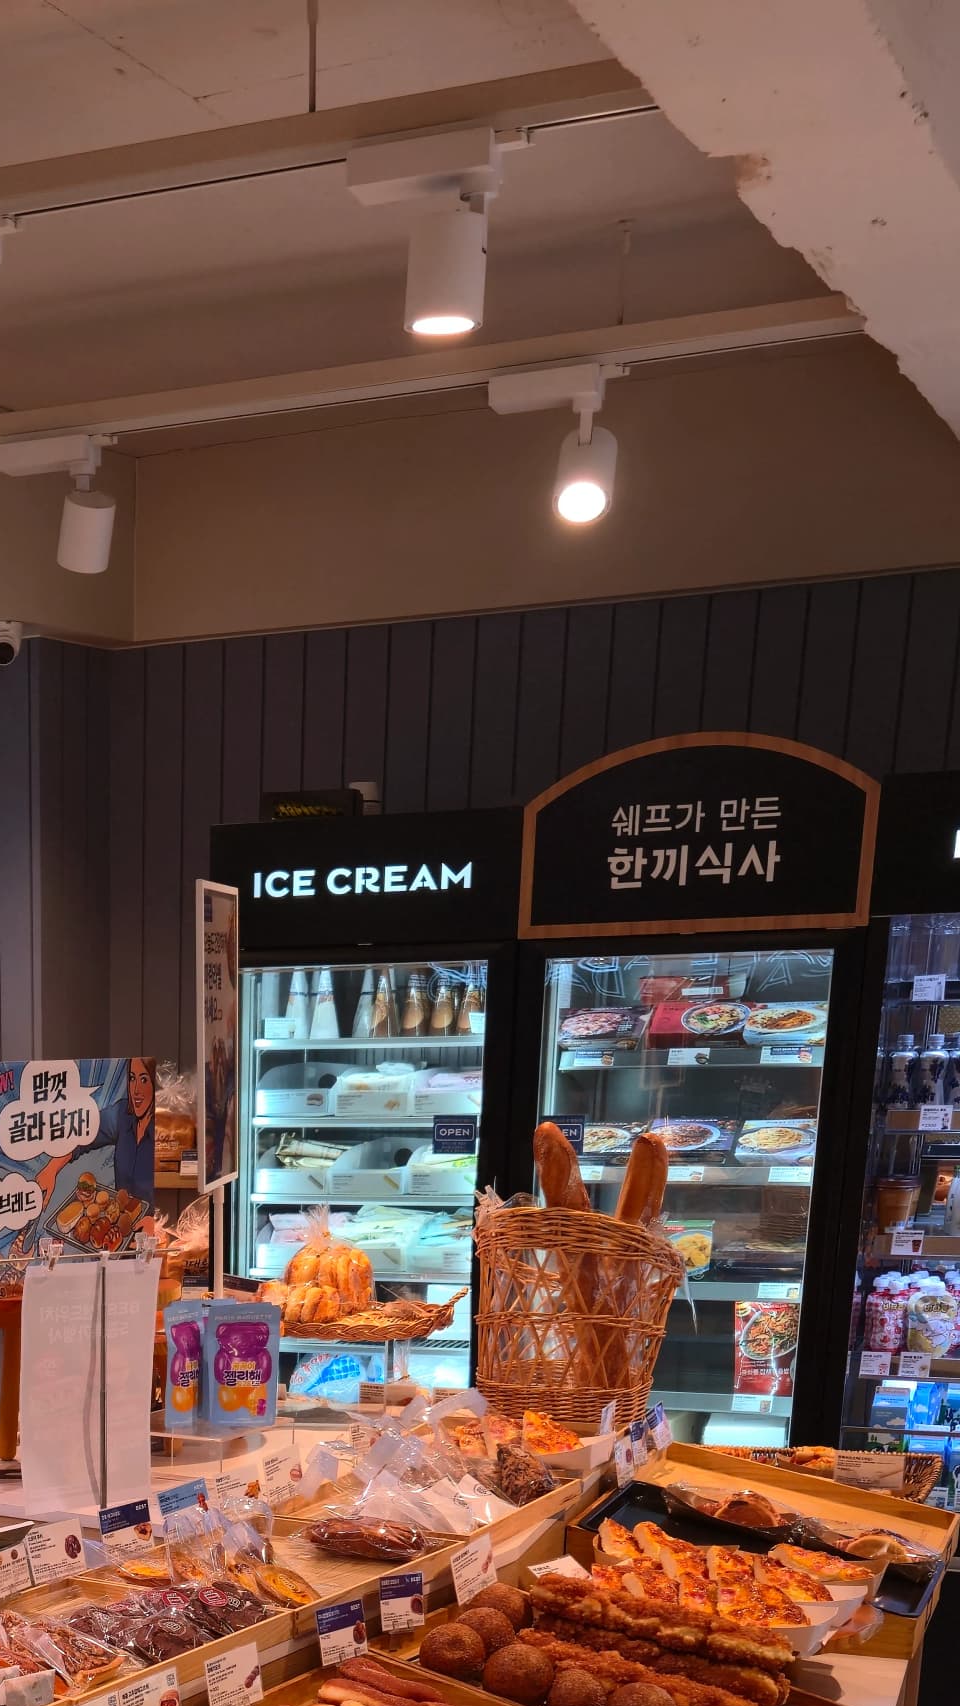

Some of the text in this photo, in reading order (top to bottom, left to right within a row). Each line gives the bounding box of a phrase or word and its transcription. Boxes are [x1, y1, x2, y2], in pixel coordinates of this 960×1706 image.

[611, 797, 782, 837] 쉐프가 만든
[253, 861, 473, 899] ICE CREAM
[607, 840, 781, 890] 한끼식사
[32, 1070, 68, 1104] 맘껏
[8, 1108, 90, 1145] 골라 담자!
[440, 1128, 470, 1137] OPEN
[562, 1129, 577, 1137] EN
